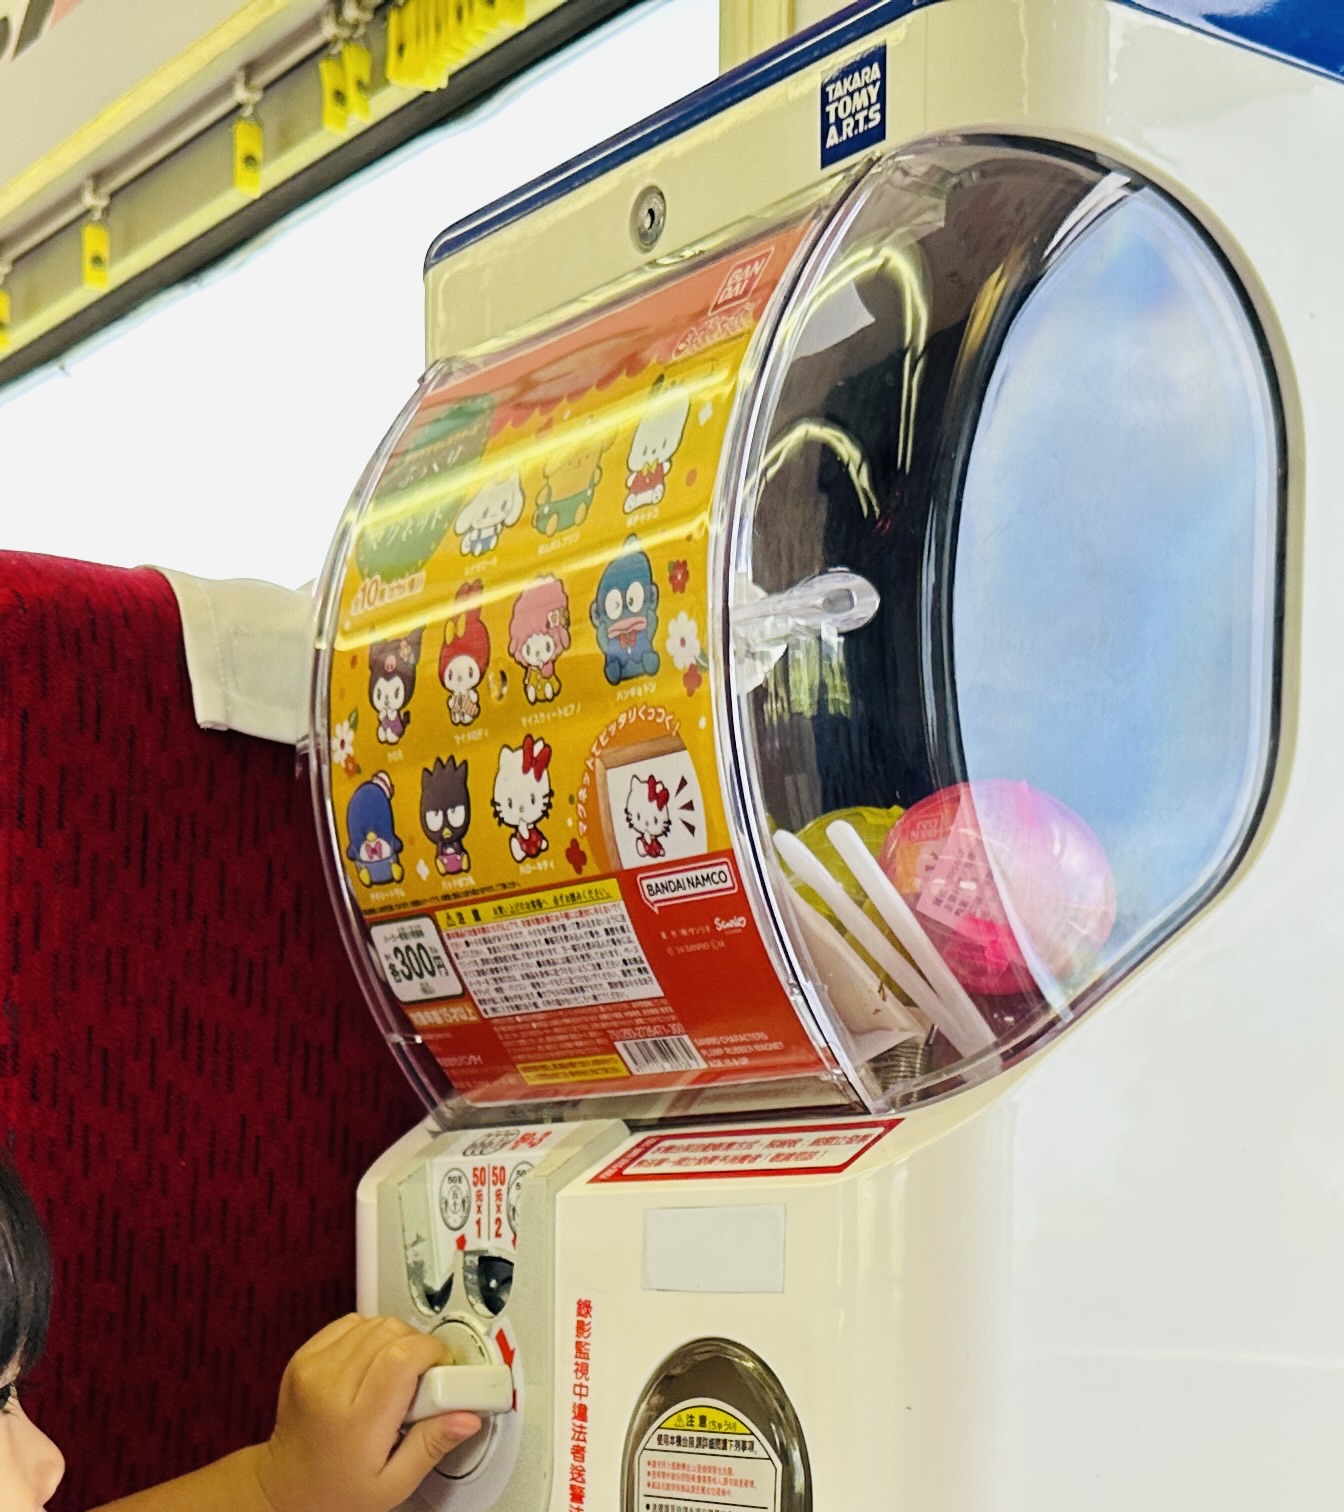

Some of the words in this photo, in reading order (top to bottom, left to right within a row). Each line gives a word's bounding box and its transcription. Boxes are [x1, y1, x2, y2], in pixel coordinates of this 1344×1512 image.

[825, 61, 881, 103] TAKARA
[825, 81, 881, 125] TOMY
[646, 878, 686, 897] BANDAI
[686, 870, 728, 893] NAMCO
